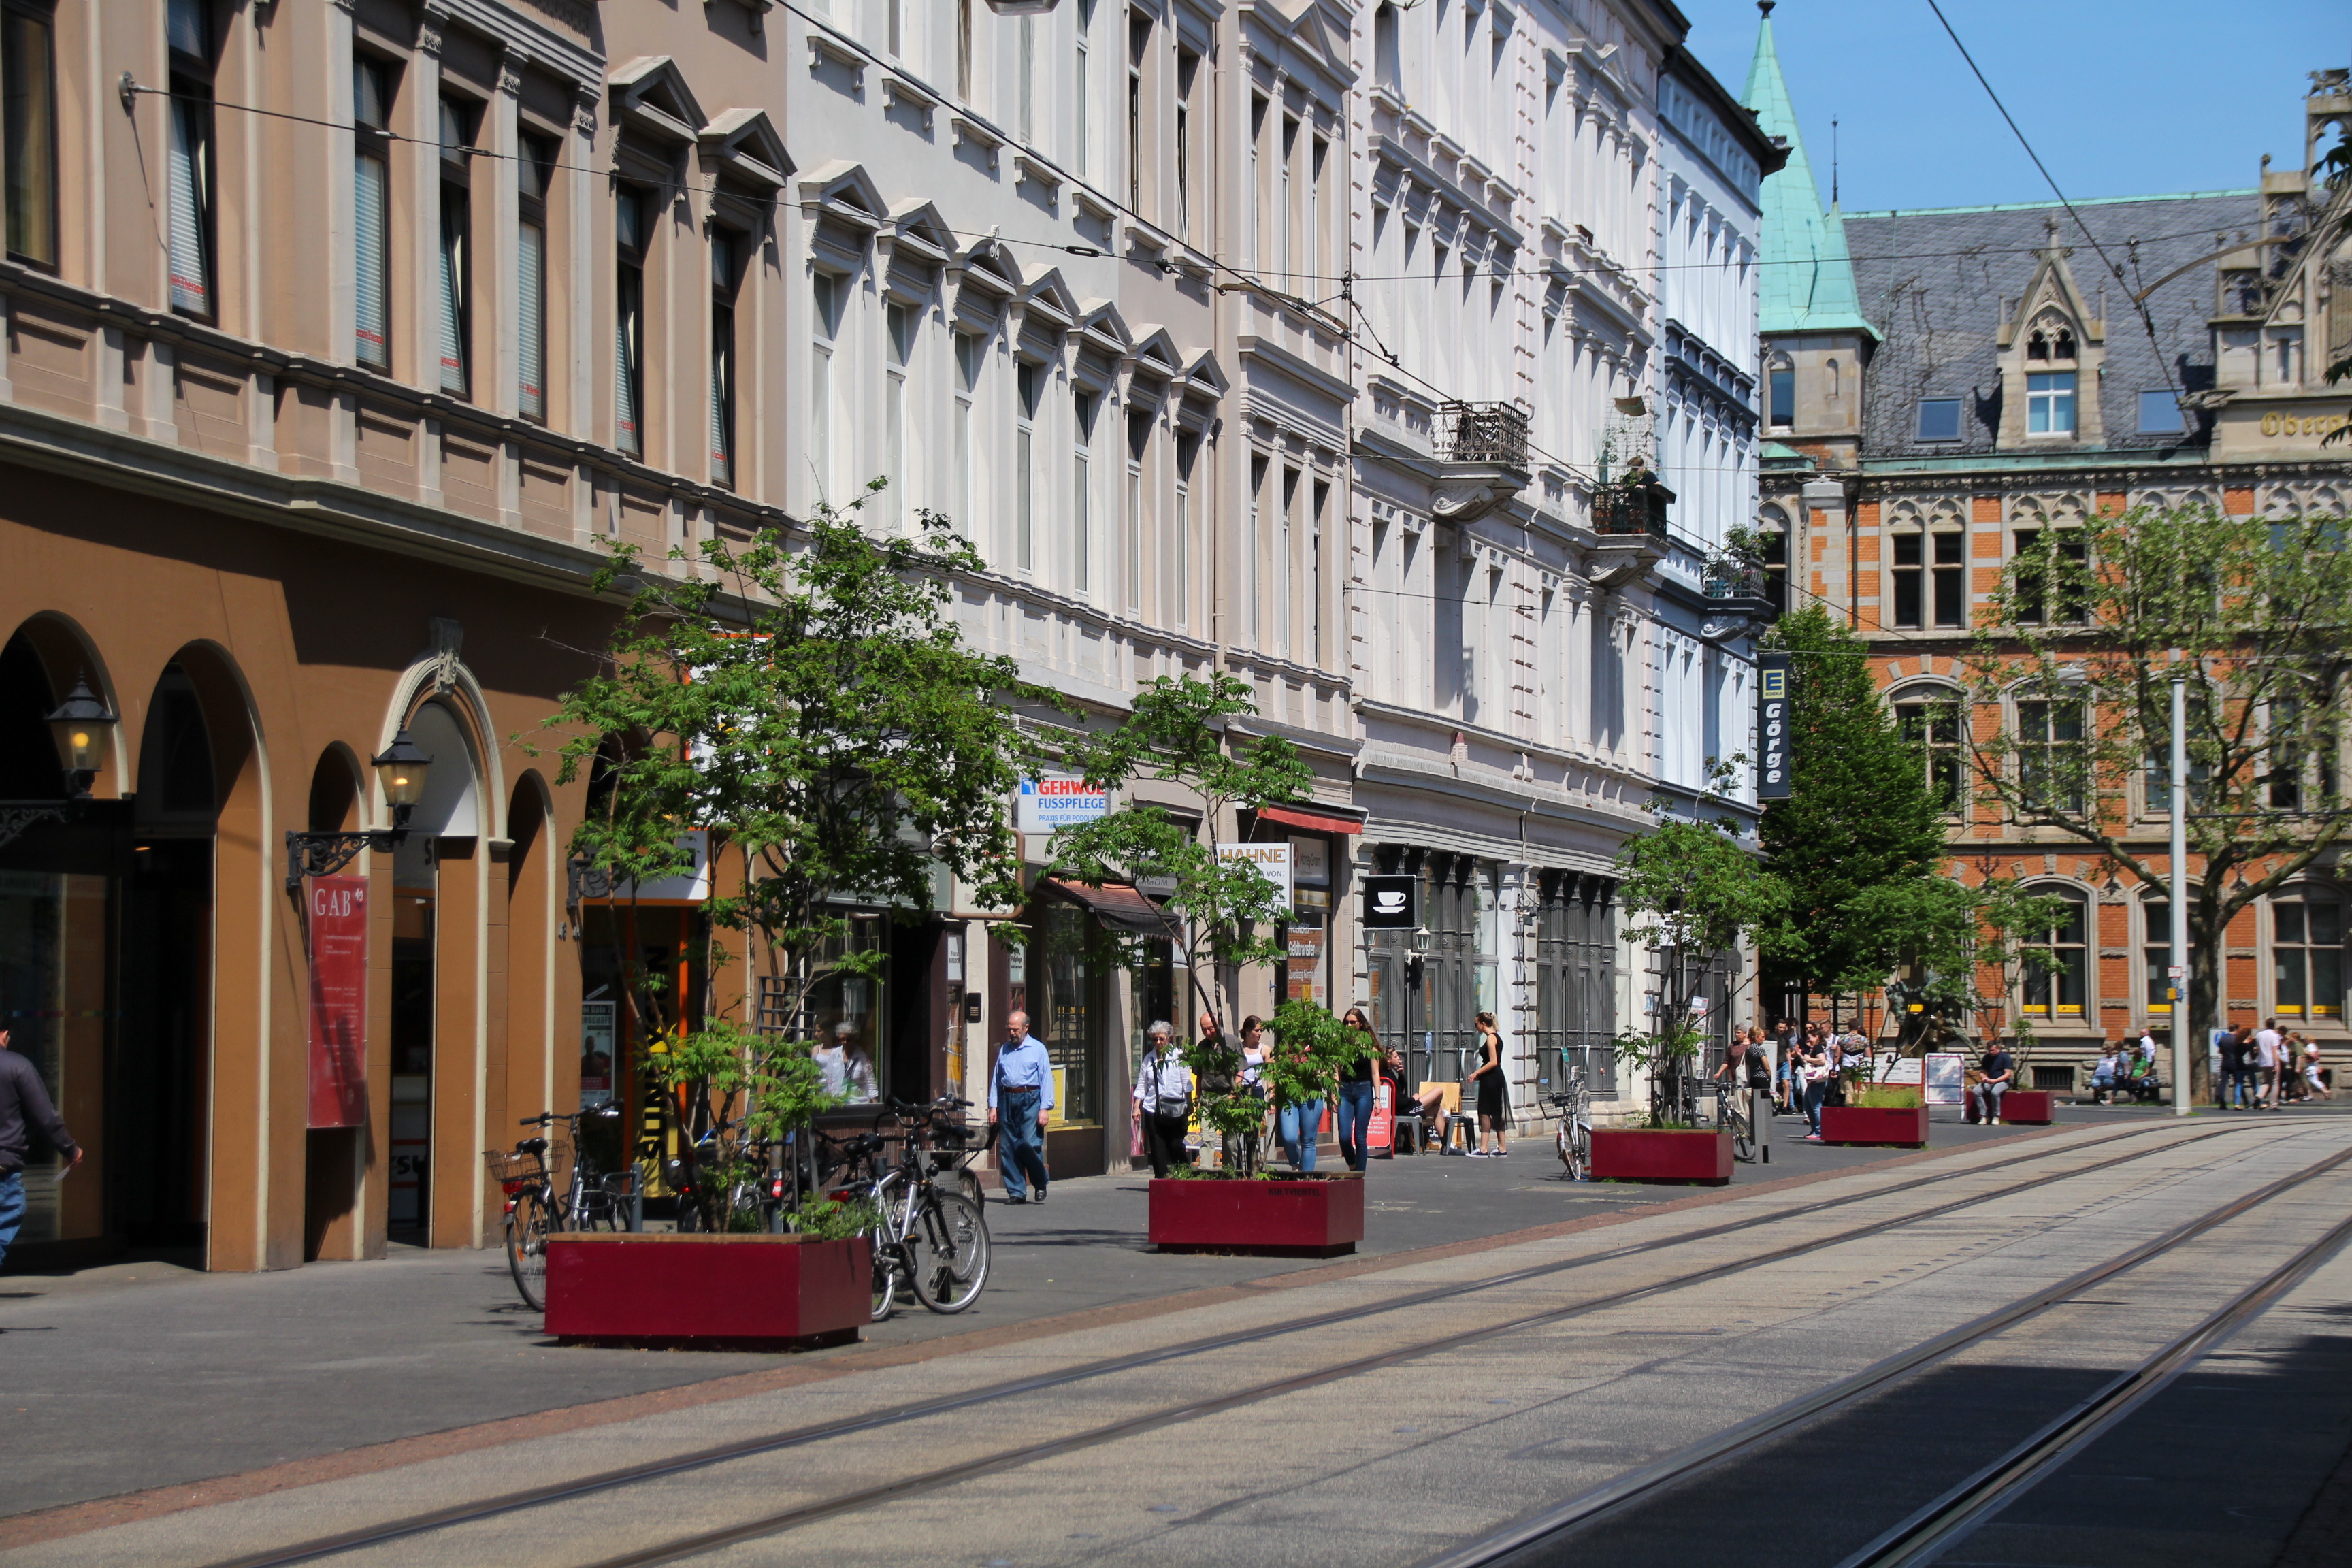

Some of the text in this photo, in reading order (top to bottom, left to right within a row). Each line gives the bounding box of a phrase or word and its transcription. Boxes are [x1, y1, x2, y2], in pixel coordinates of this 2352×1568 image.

[1765, 703, 1782, 783] Görge
[1038, 798, 1105, 809] FUSSPFLEGE
[1060, 813, 1071, 821] FÜR
[1220, 849, 1286, 863] HAHNE
[1299, 851, 1321, 868] MoneyGram
[315, 888, 351, 917] GAB
[1288, 941, 1316, 956] Geldtransfer
[1268, 1188, 1322, 1196] KULTVIERTEL
